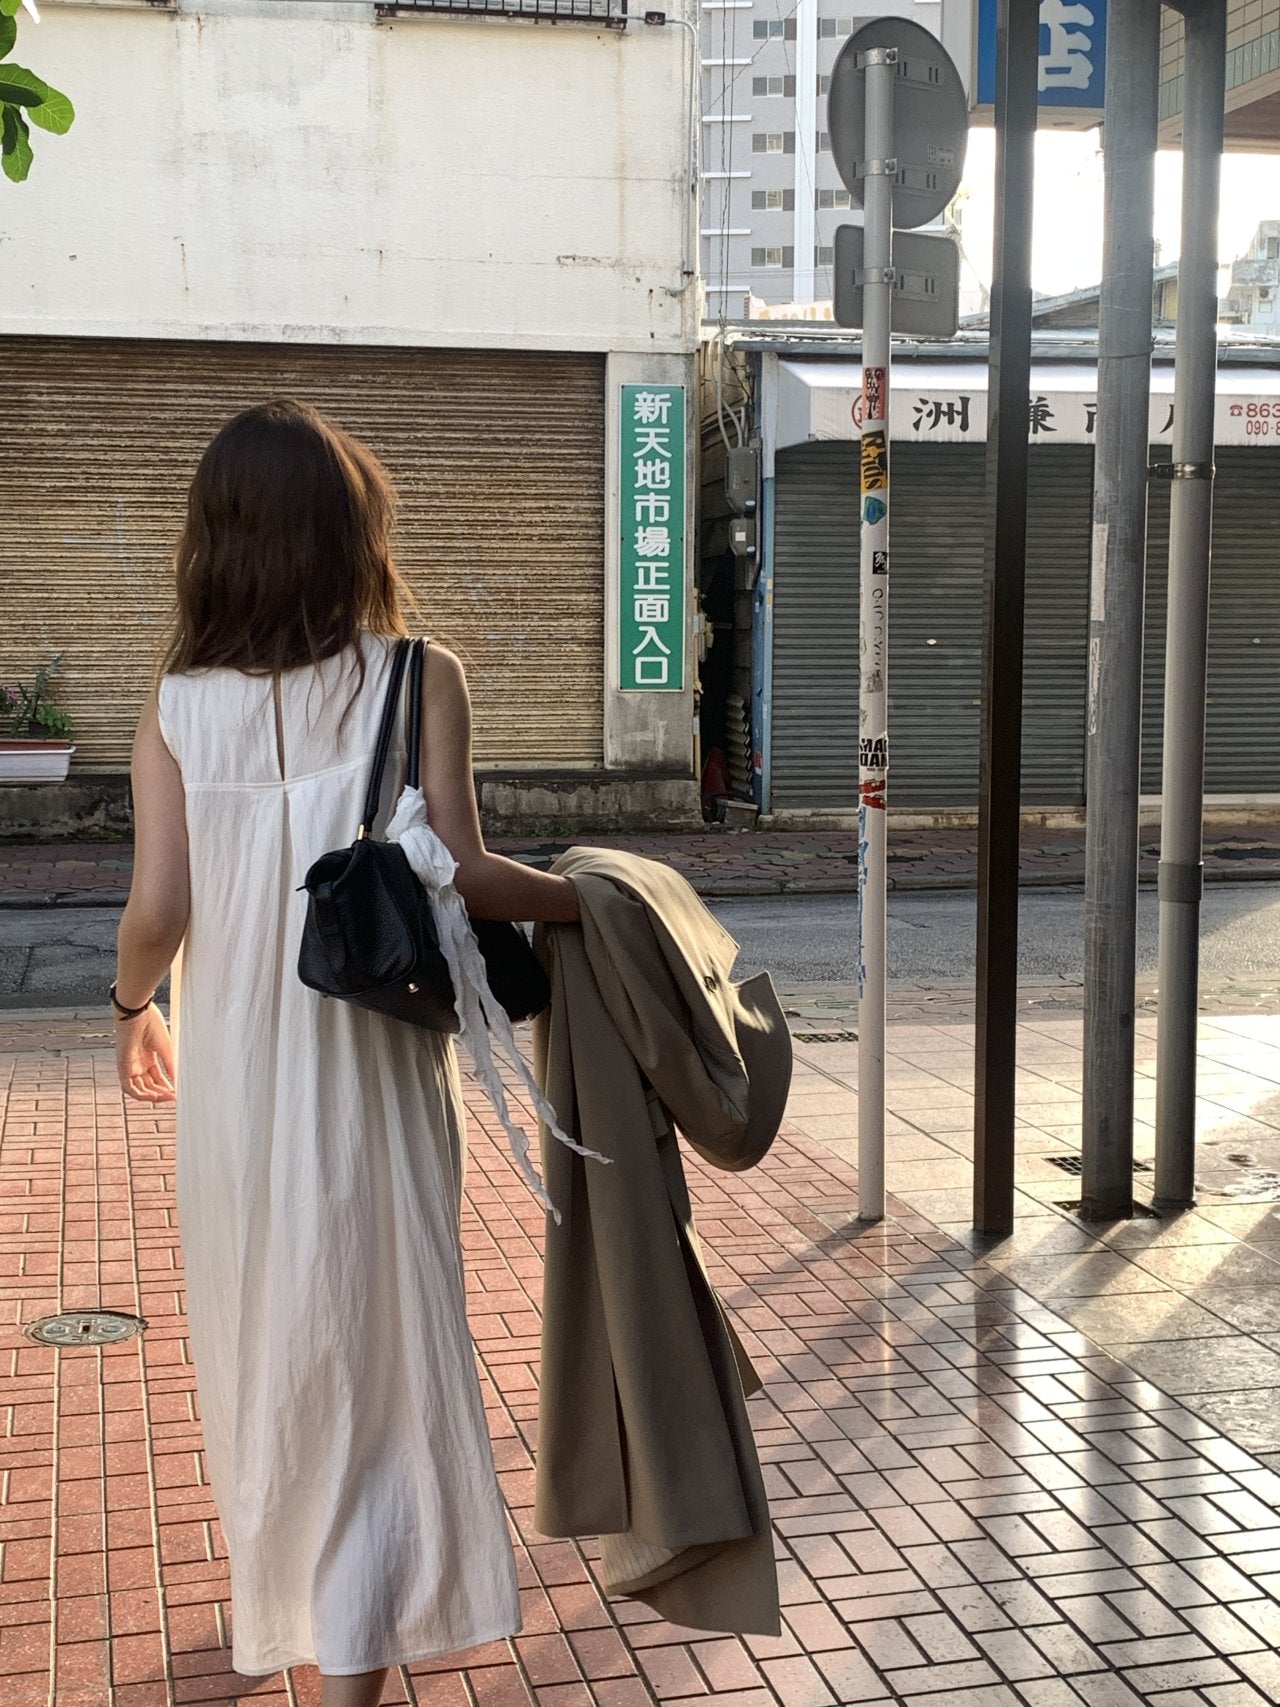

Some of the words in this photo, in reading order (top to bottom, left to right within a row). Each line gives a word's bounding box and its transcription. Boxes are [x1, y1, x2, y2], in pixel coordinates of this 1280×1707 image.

[632, 391, 672, 685] 新天地市場正面入口
